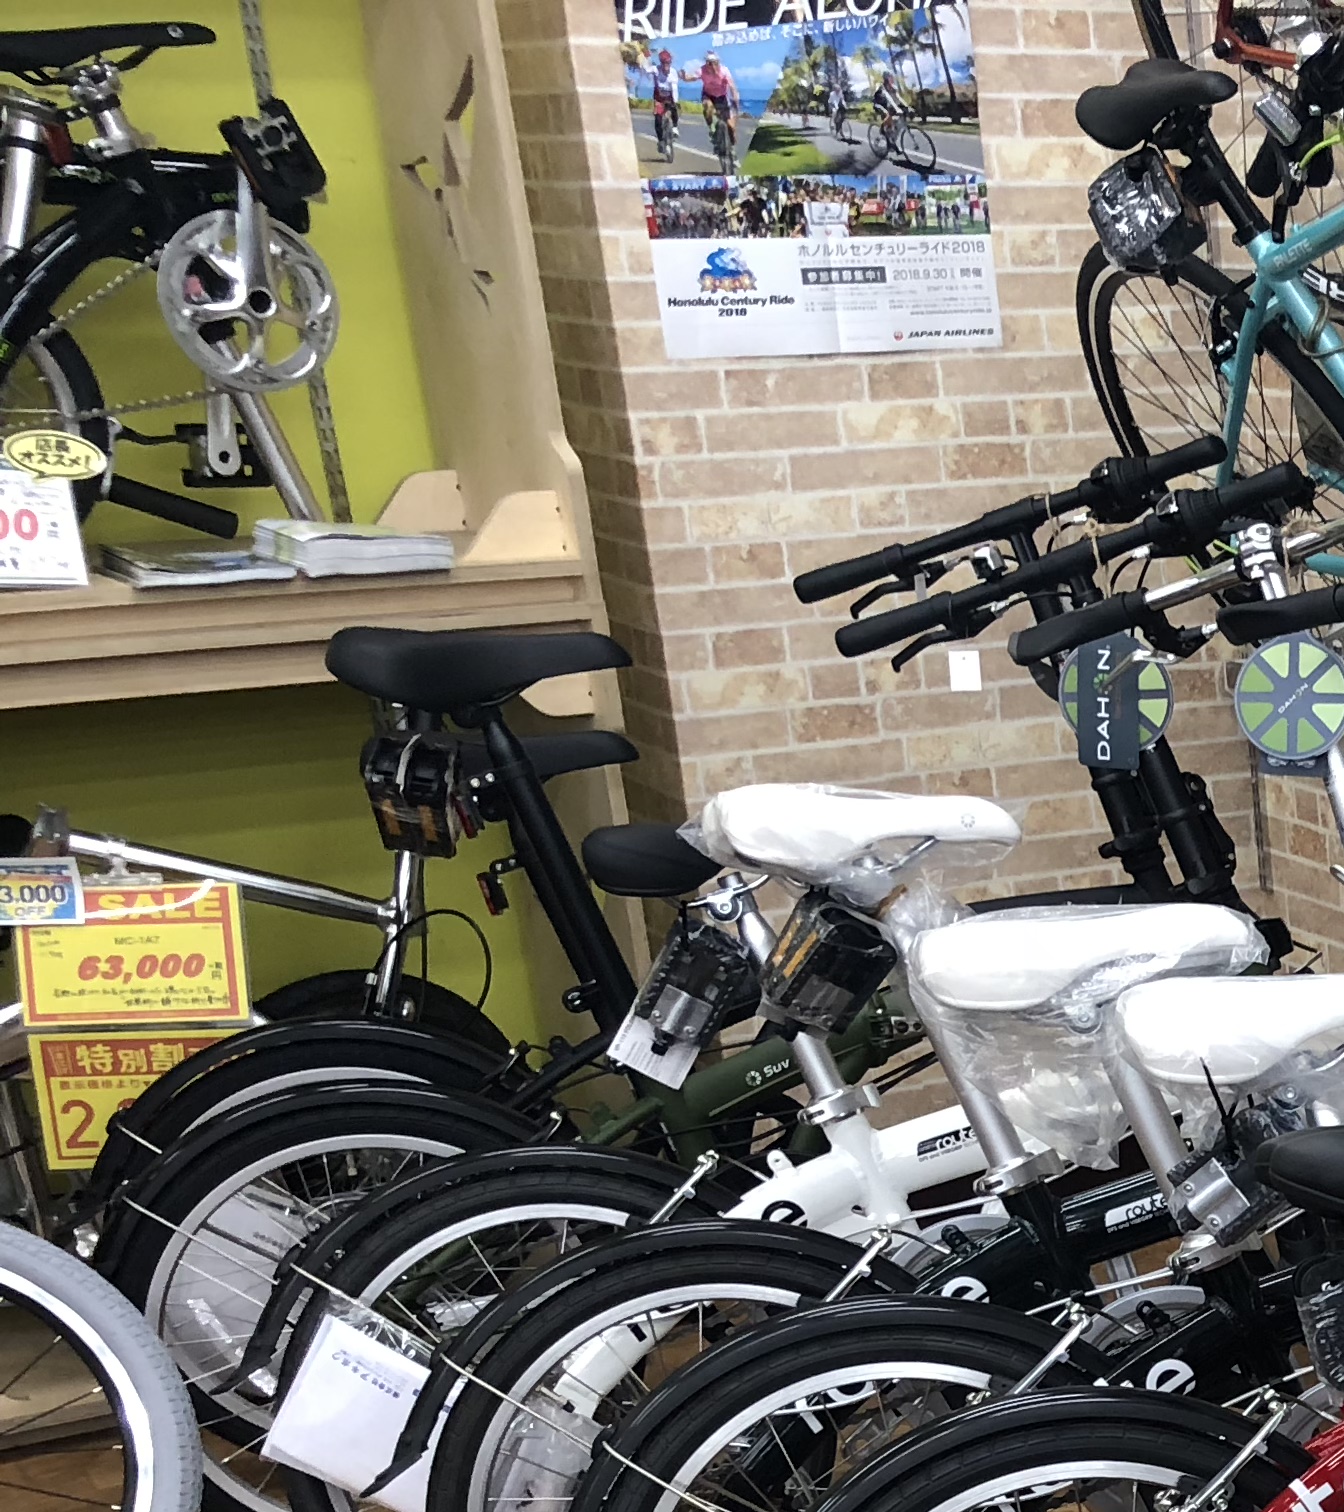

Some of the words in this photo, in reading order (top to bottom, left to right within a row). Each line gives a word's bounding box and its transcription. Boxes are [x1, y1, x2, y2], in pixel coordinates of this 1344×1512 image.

[667, 296, 719, 308] Honolulu
[720, 296, 767, 309] Century
[769, 294, 795, 306] Ride
[908, 329, 941, 338] JAPAN
[944, 327, 994, 336] AIRLINES
[1096, 644, 1112, 762] DAHON
[1276, 681, 1310, 716] DAHON
[98, 891, 222, 920] SALE
[78, 953, 206, 984] 63,000
[76, 1043, 186, 1073] 特別割
